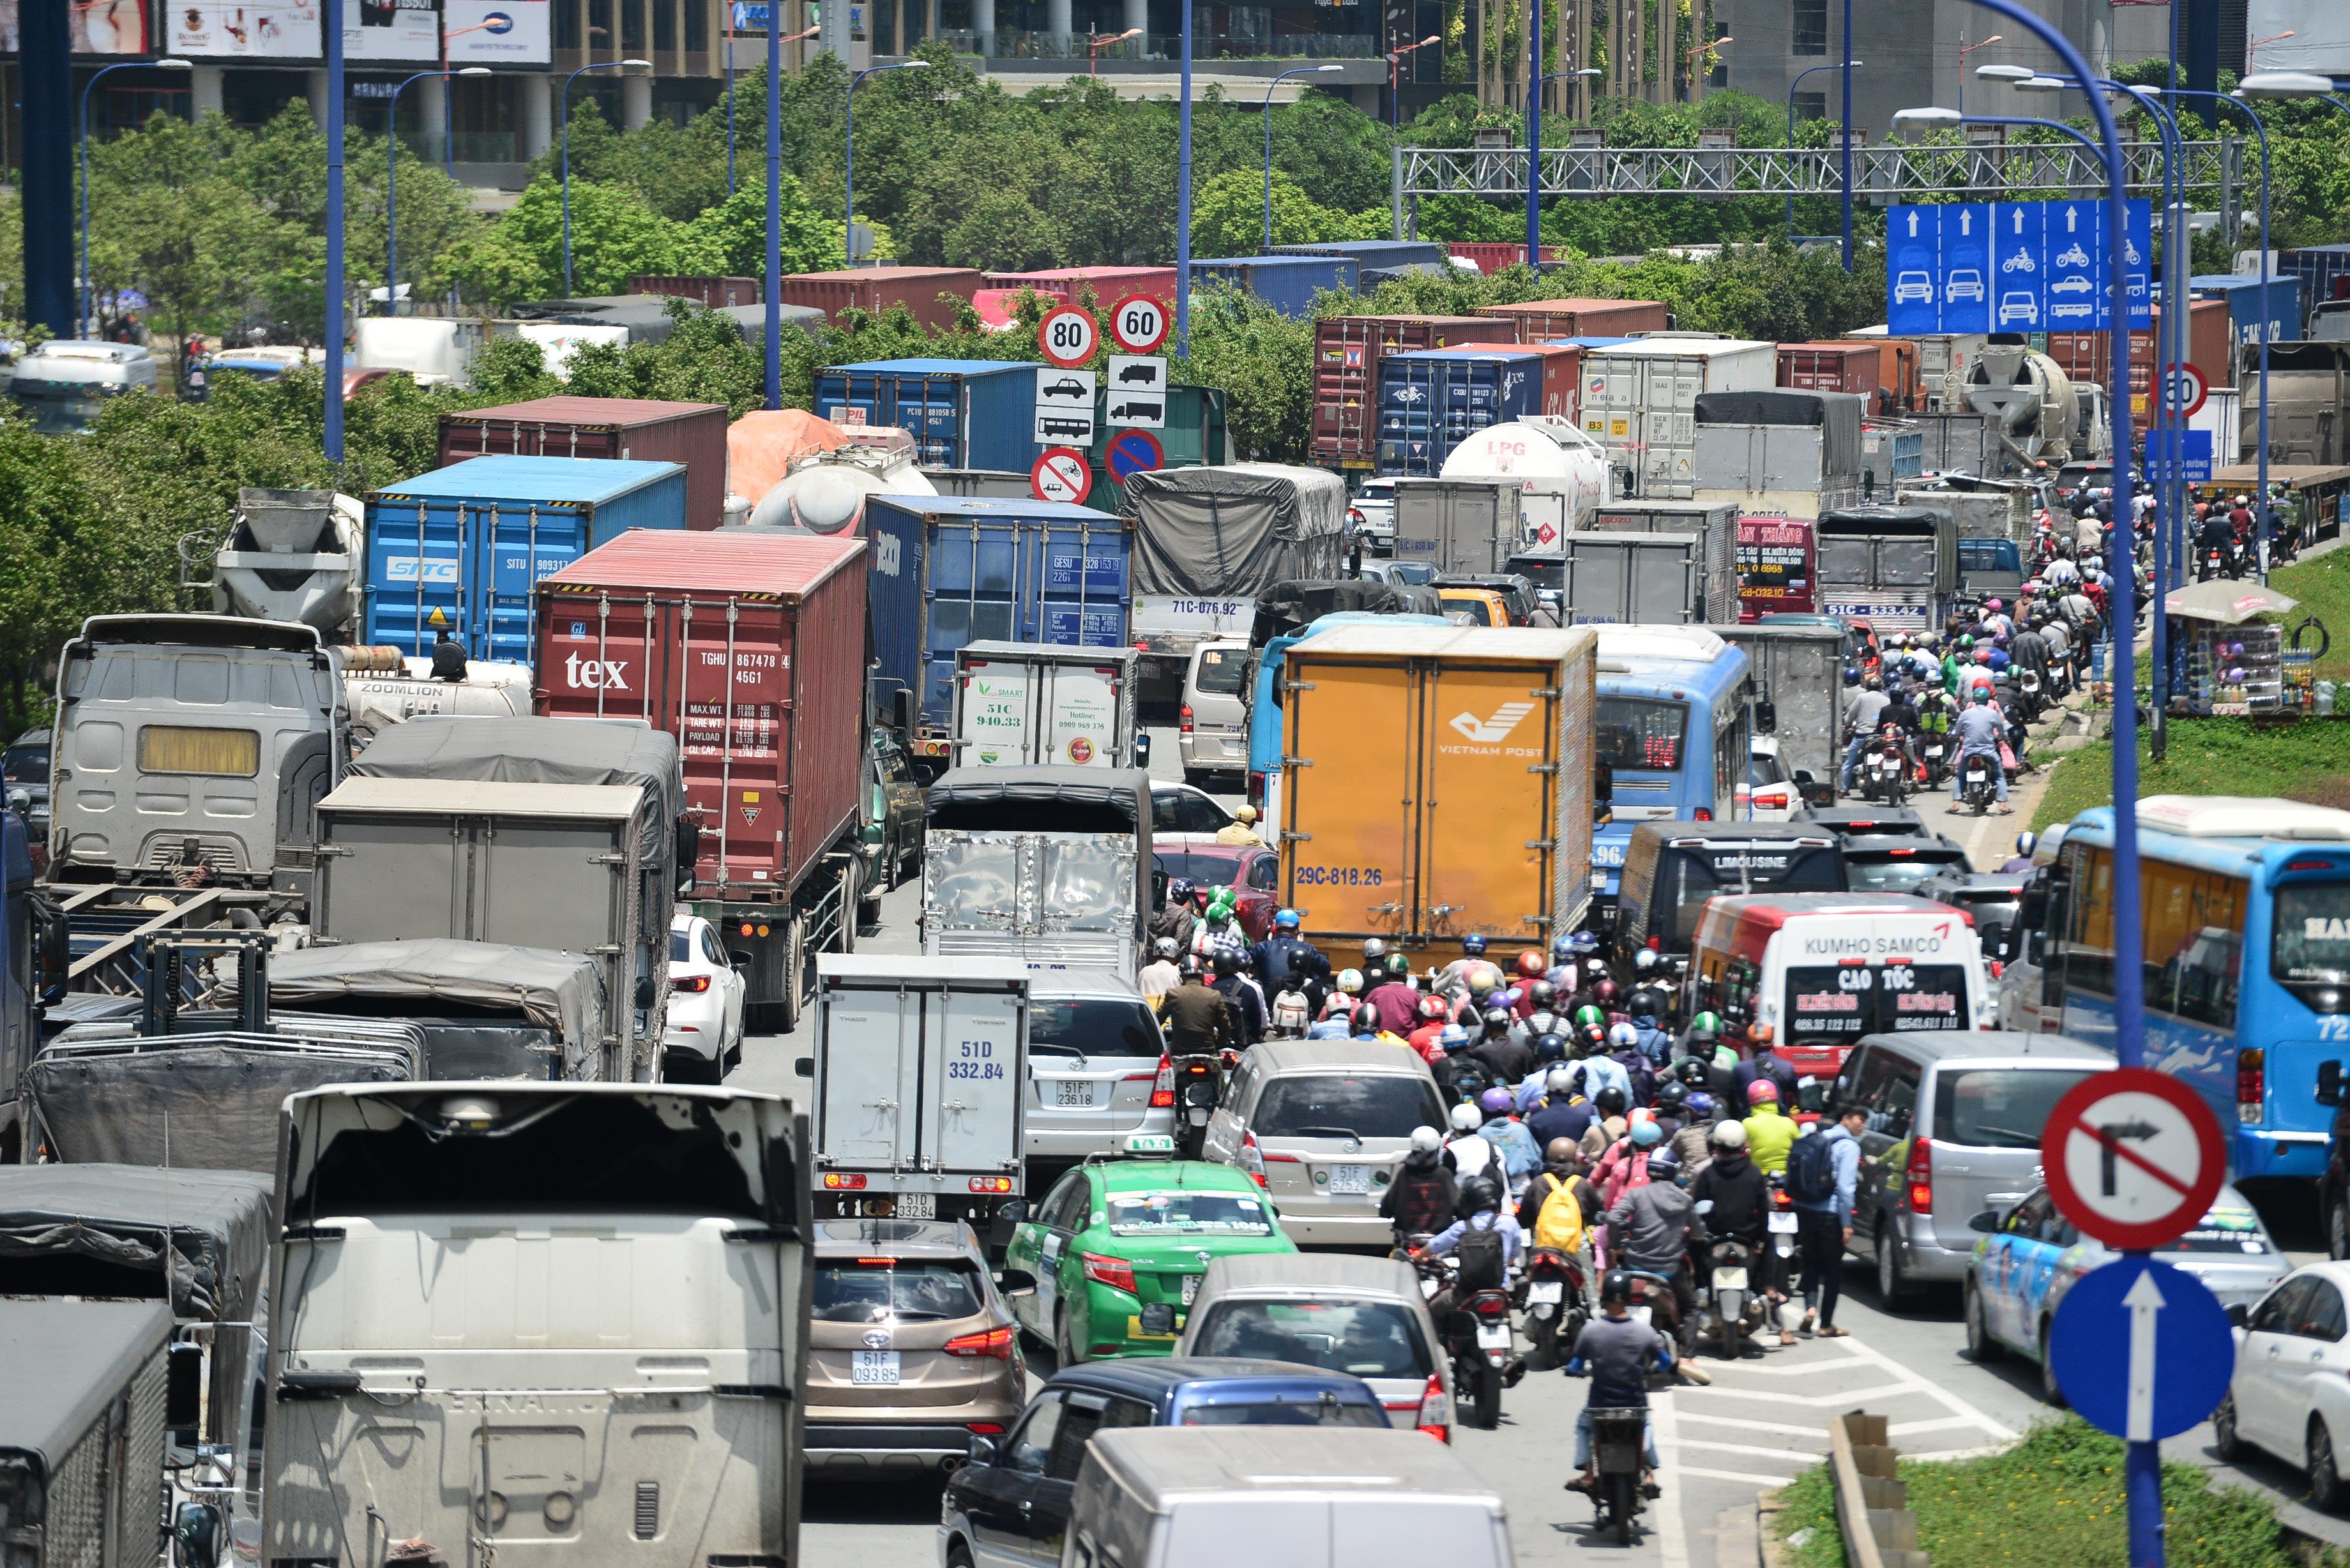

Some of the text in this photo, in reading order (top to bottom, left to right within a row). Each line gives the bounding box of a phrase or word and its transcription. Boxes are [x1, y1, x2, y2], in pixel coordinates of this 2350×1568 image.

[2101, 304, 2148, 316] XE BÁNH
[1126, 311, 1154, 336] 60
[1054, 322, 1082, 347] 80
[848, 410, 865, 419] PIL
[907, 407, 922, 416] PCIU
[1589, 421, 1602, 429] B3
[1487, 441, 1526, 456] LPG
[388, 562, 457, 577] SITC
[506, 558, 568, 571] SITU 909317
[1054, 557, 1072, 569] GESU
[1085, 558, 1111, 570] 328153
[1761, 564, 1783, 573] 6968
[1052, 571, 1071, 582] 22G1
[1172, 600, 1237, 615] 71C-076.92
[1828, 605, 1919, 615] 51C 533.42
[572, 622, 586, 635] GL
[701, 652, 790, 668] TGHU 867478 4
[736, 671, 761, 684] 45G1
[361, 683, 443, 697] ZOOMLION
[998, 688, 1023, 697] SMART
[987, 704, 1012, 714] 51C
[1070, 711, 1096, 720] Hotline:
[690, 718, 707, 728] TARE
[976, 715, 1021, 727] 940.33
[689, 732, 720, 741] PAYLOAD
[688, 745, 700, 755] CU.
[701, 746, 718, 755] CAP.
[1439, 745, 1545, 758] VIETNAM POST
[1714, 856, 1788, 869] LIMOUSINE
[1296, 866, 1382, 887] 29C-818.26
[1805, 937, 1941, 953] KUMHO SAMCO
[1838, 964, 1915, 990] CAO TỐC
[838, 1014, 867, 1022] THACO
[971, 1017, 1007, 1025] TOWNER
[961, 1040, 992, 1058] 51D
[949, 1062, 1004, 1080] 332.84
[1065, 1082, 1084, 1094] 51F
[1058, 1094, 1091, 1106] 236.18
[1340, 1166, 1361, 1177] 51F
[1331, 1180, 1369, 1193] 525.29
[906, 1193, 927, 1205] 51D
[898, 1205, 934, 1218] 332.84
[863, 1352, 888, 1366] 51F
[854, 1368, 897, 1382] 093.85
